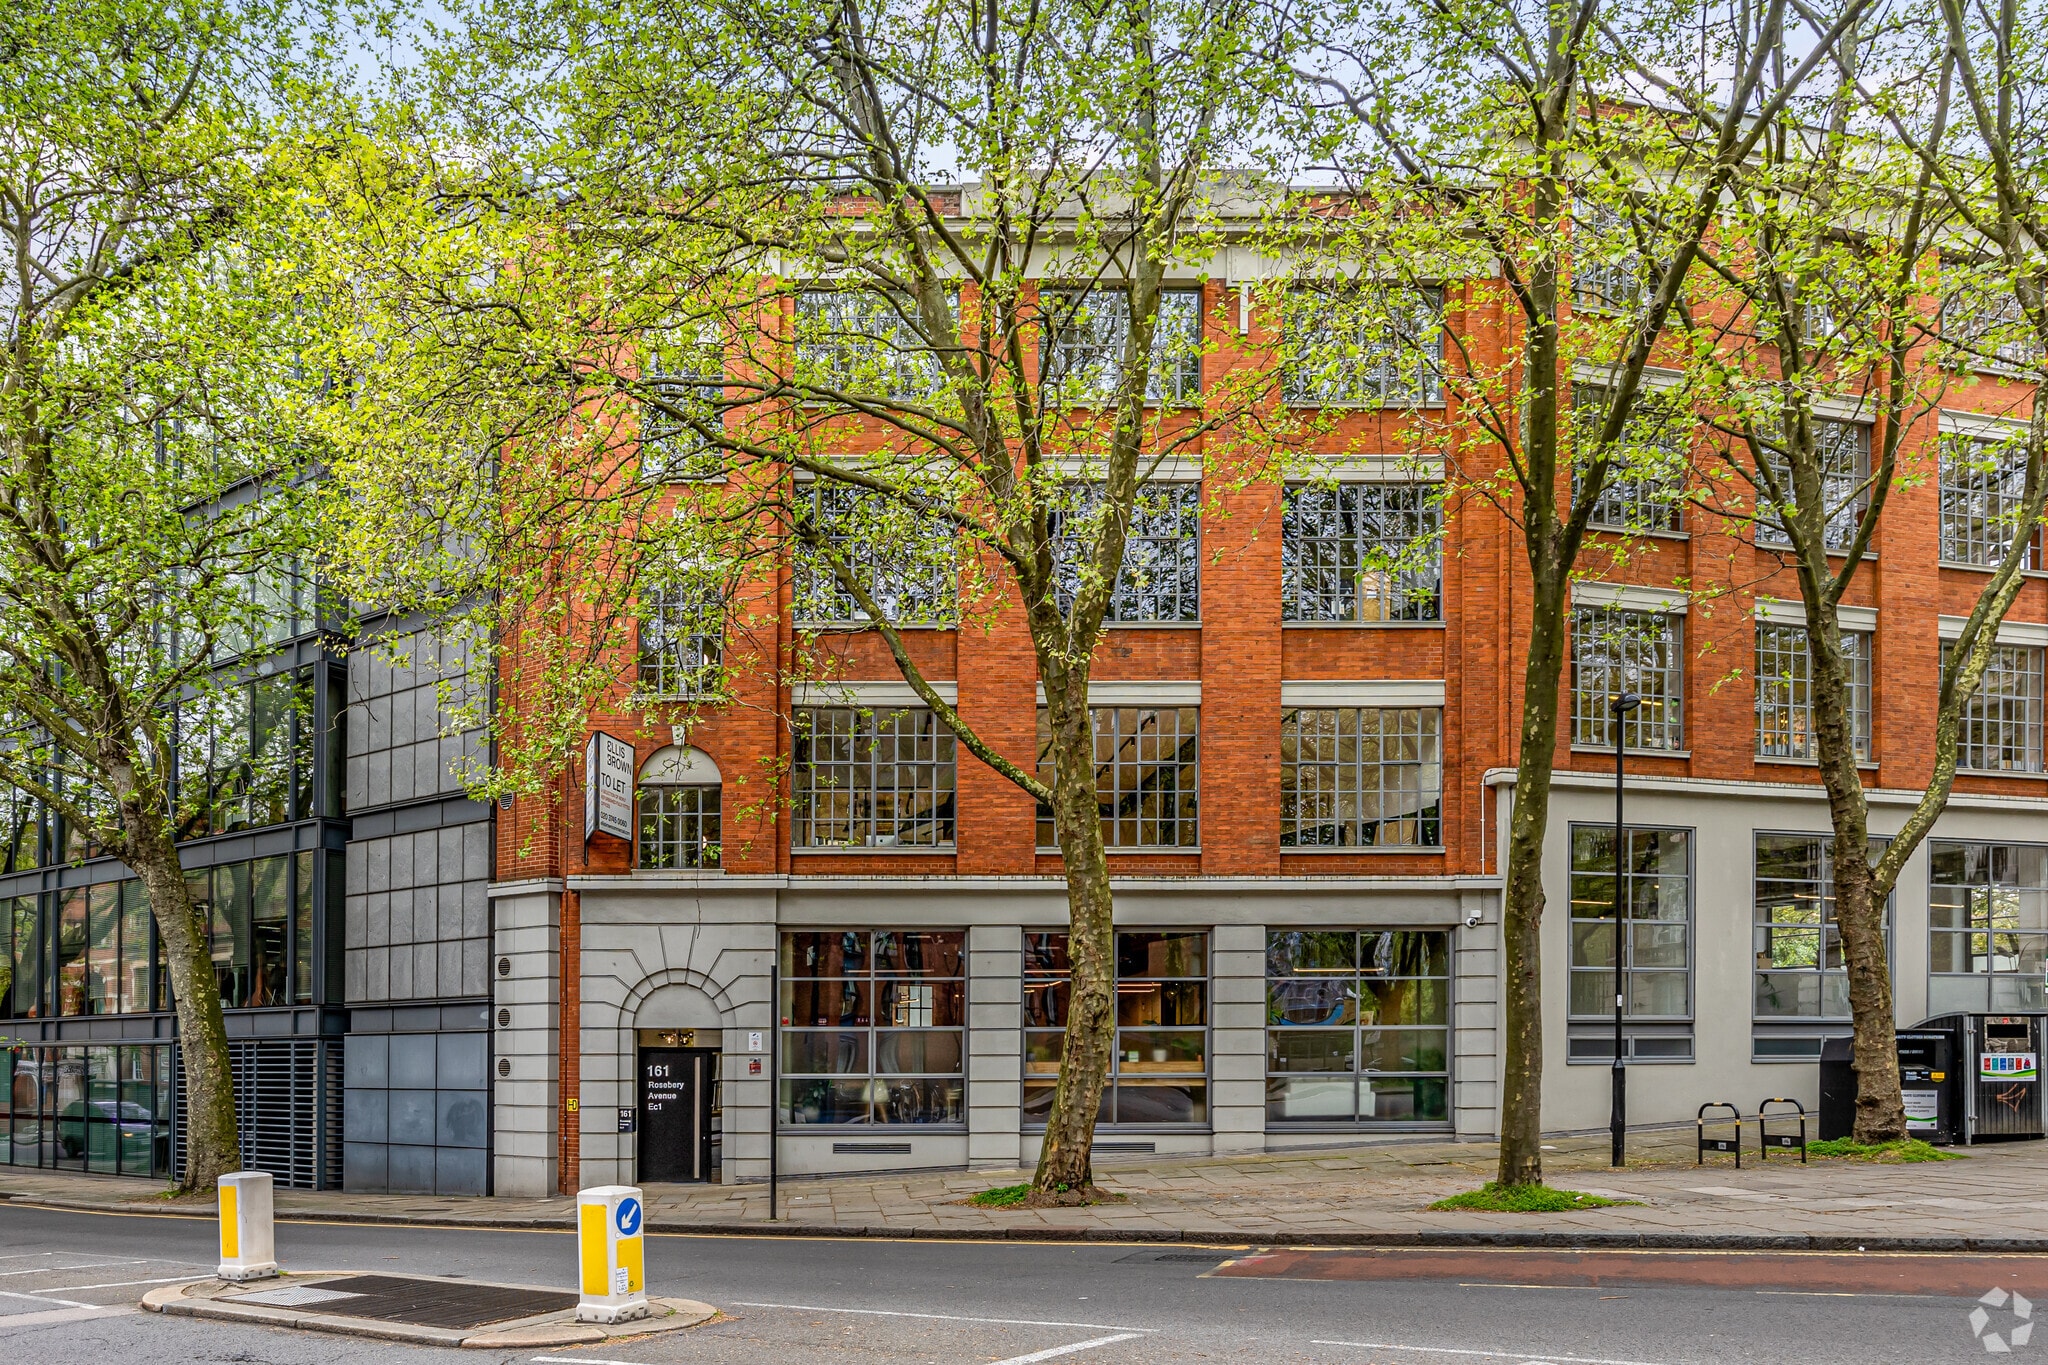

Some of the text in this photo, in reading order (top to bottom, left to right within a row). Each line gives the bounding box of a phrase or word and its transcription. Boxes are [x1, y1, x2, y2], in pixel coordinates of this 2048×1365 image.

[606, 740, 626, 759] ELLIS
[601, 772, 626, 794] TO LET
[647, 1065, 669, 1077] 161
[648, 1081, 684, 1090] Rosebery
[647, 1092, 677, 1100] Avenue
[648, 1102, 662, 1111] Ec1
[620, 1110, 631, 1118] 161
